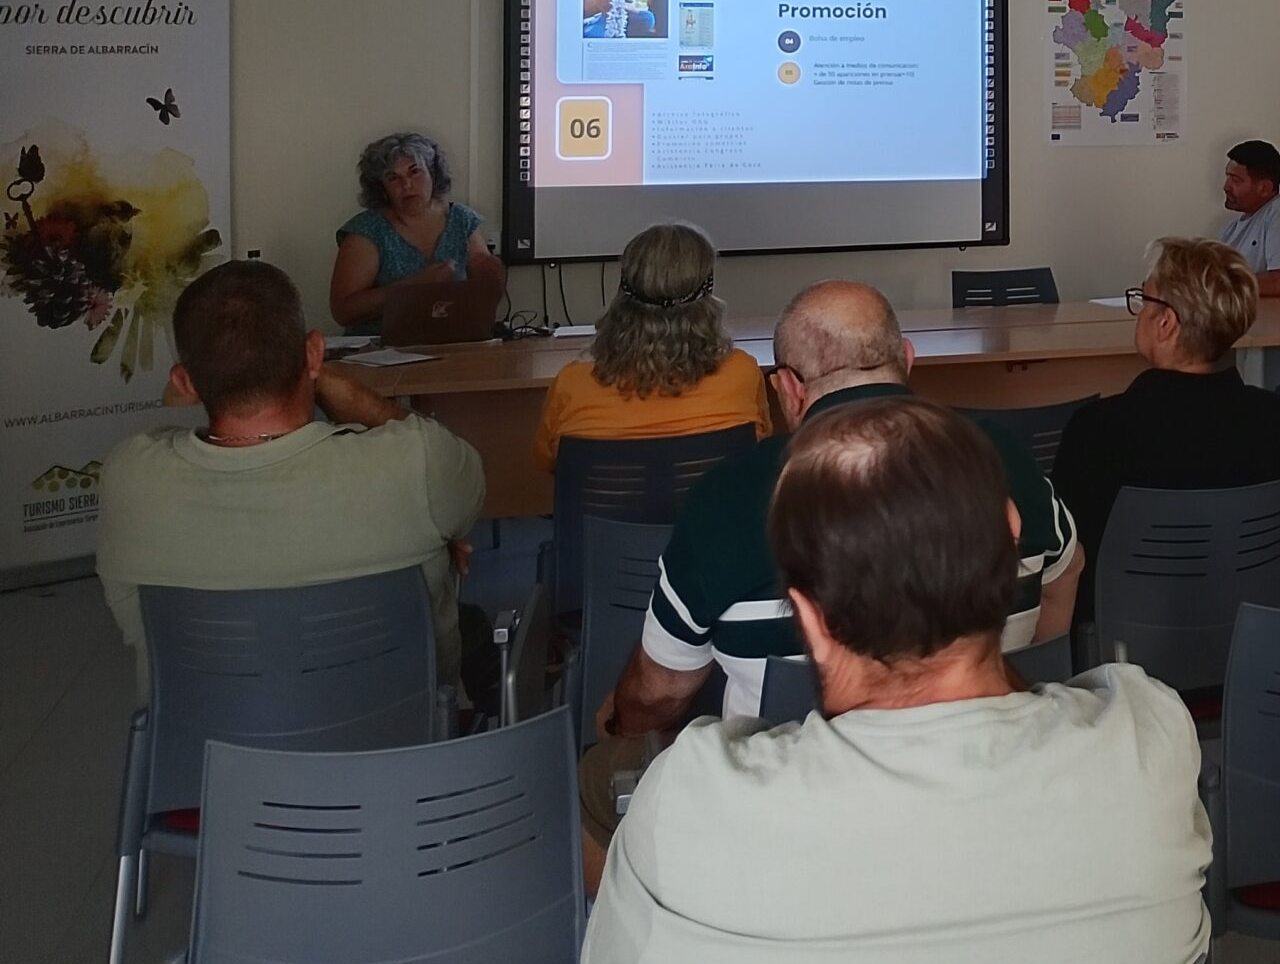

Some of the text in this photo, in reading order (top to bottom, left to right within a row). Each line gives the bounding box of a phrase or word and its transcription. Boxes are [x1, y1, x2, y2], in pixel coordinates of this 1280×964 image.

[778, 2, 887, 19] Promoción
[25, 43, 159, 55] SIERRA DE ALBARRACÍN
[570, 118, 601, 138] 06
[23, 498, 65, 517] TURISMO
